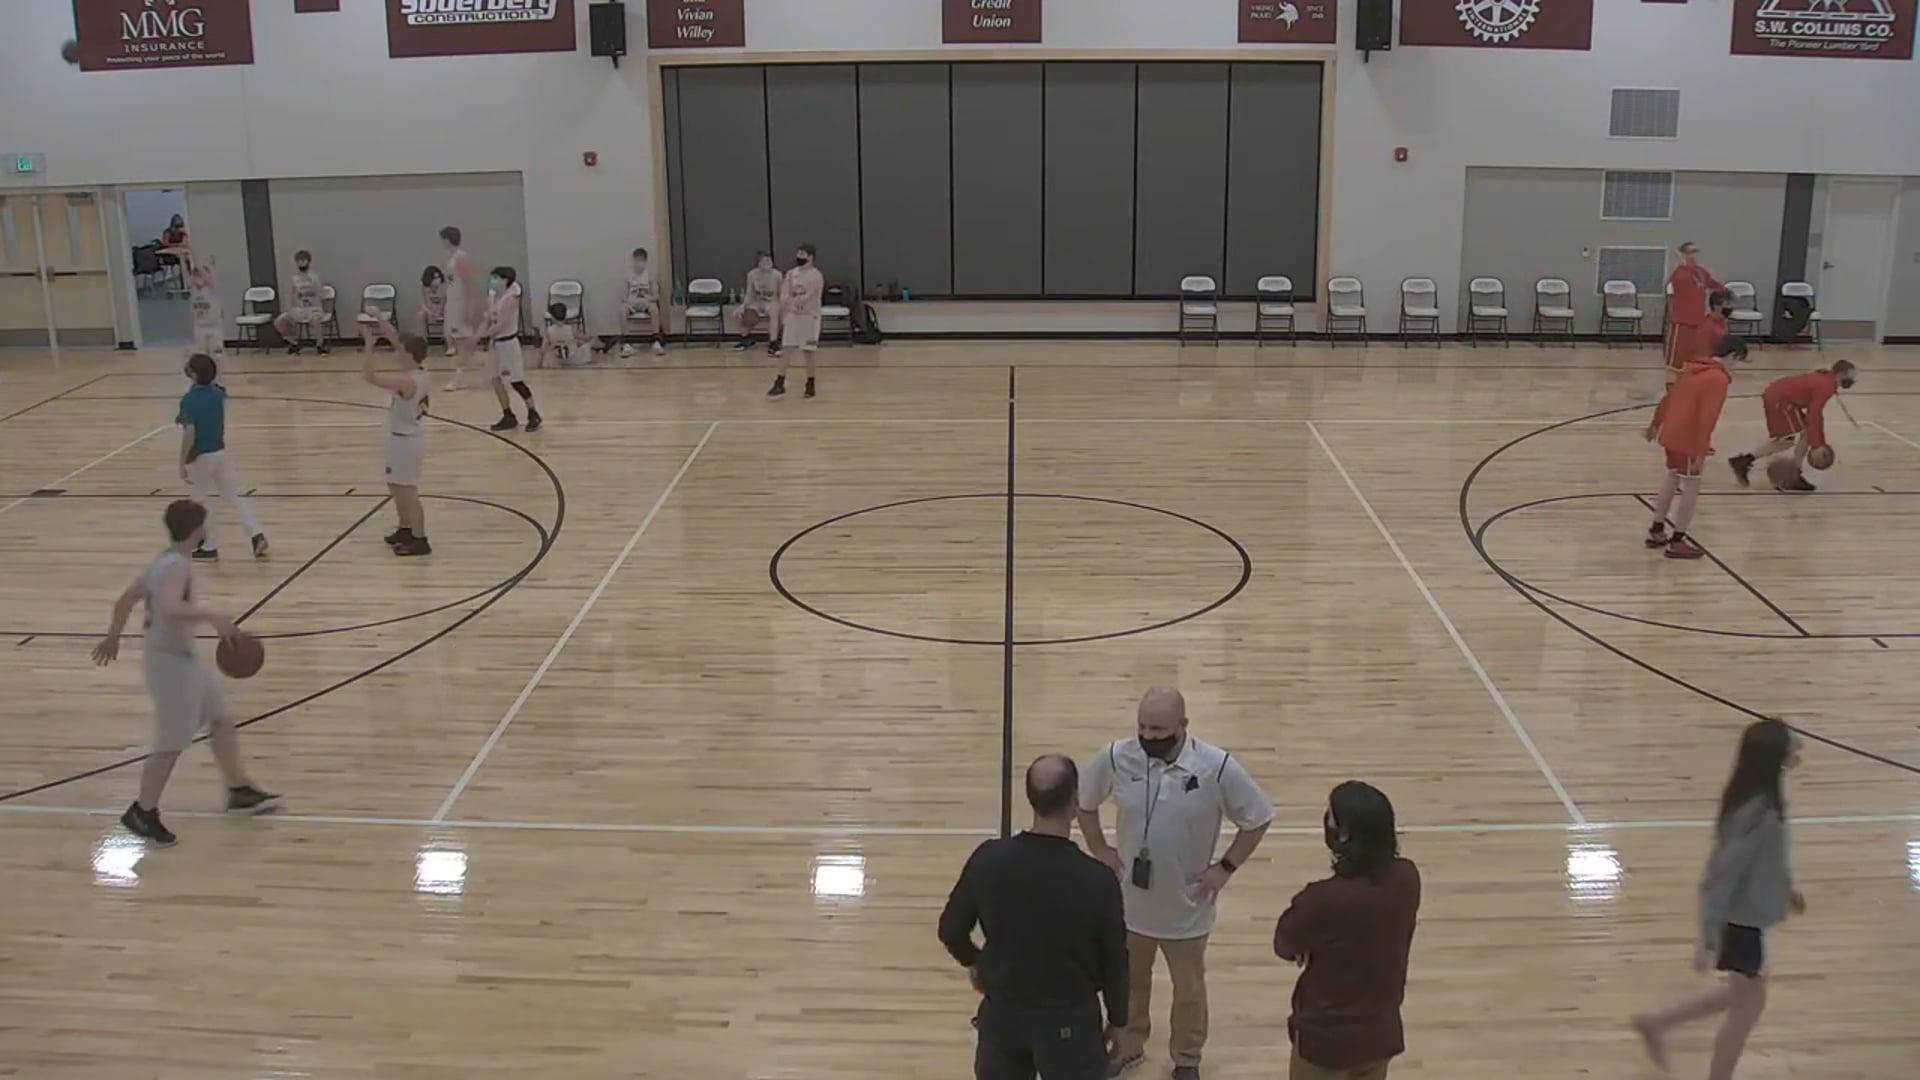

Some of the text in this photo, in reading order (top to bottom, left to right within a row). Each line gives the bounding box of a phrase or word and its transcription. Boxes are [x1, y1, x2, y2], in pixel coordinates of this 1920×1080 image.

[971, 0, 1012, 9] Credit
[414, 11, 531, 23] CONSTRUCTION
[677, 8, 713, 20] Vivian
[120, 8, 205, 40] MMG
[972, 14, 1012, 28] Union
[1467, 9, 1528, 33] INTERNATIONAL
[1755, 20, 1895, 37] S.W. COLLINS CO.
[124, 41, 205, 53] INSURANCE
